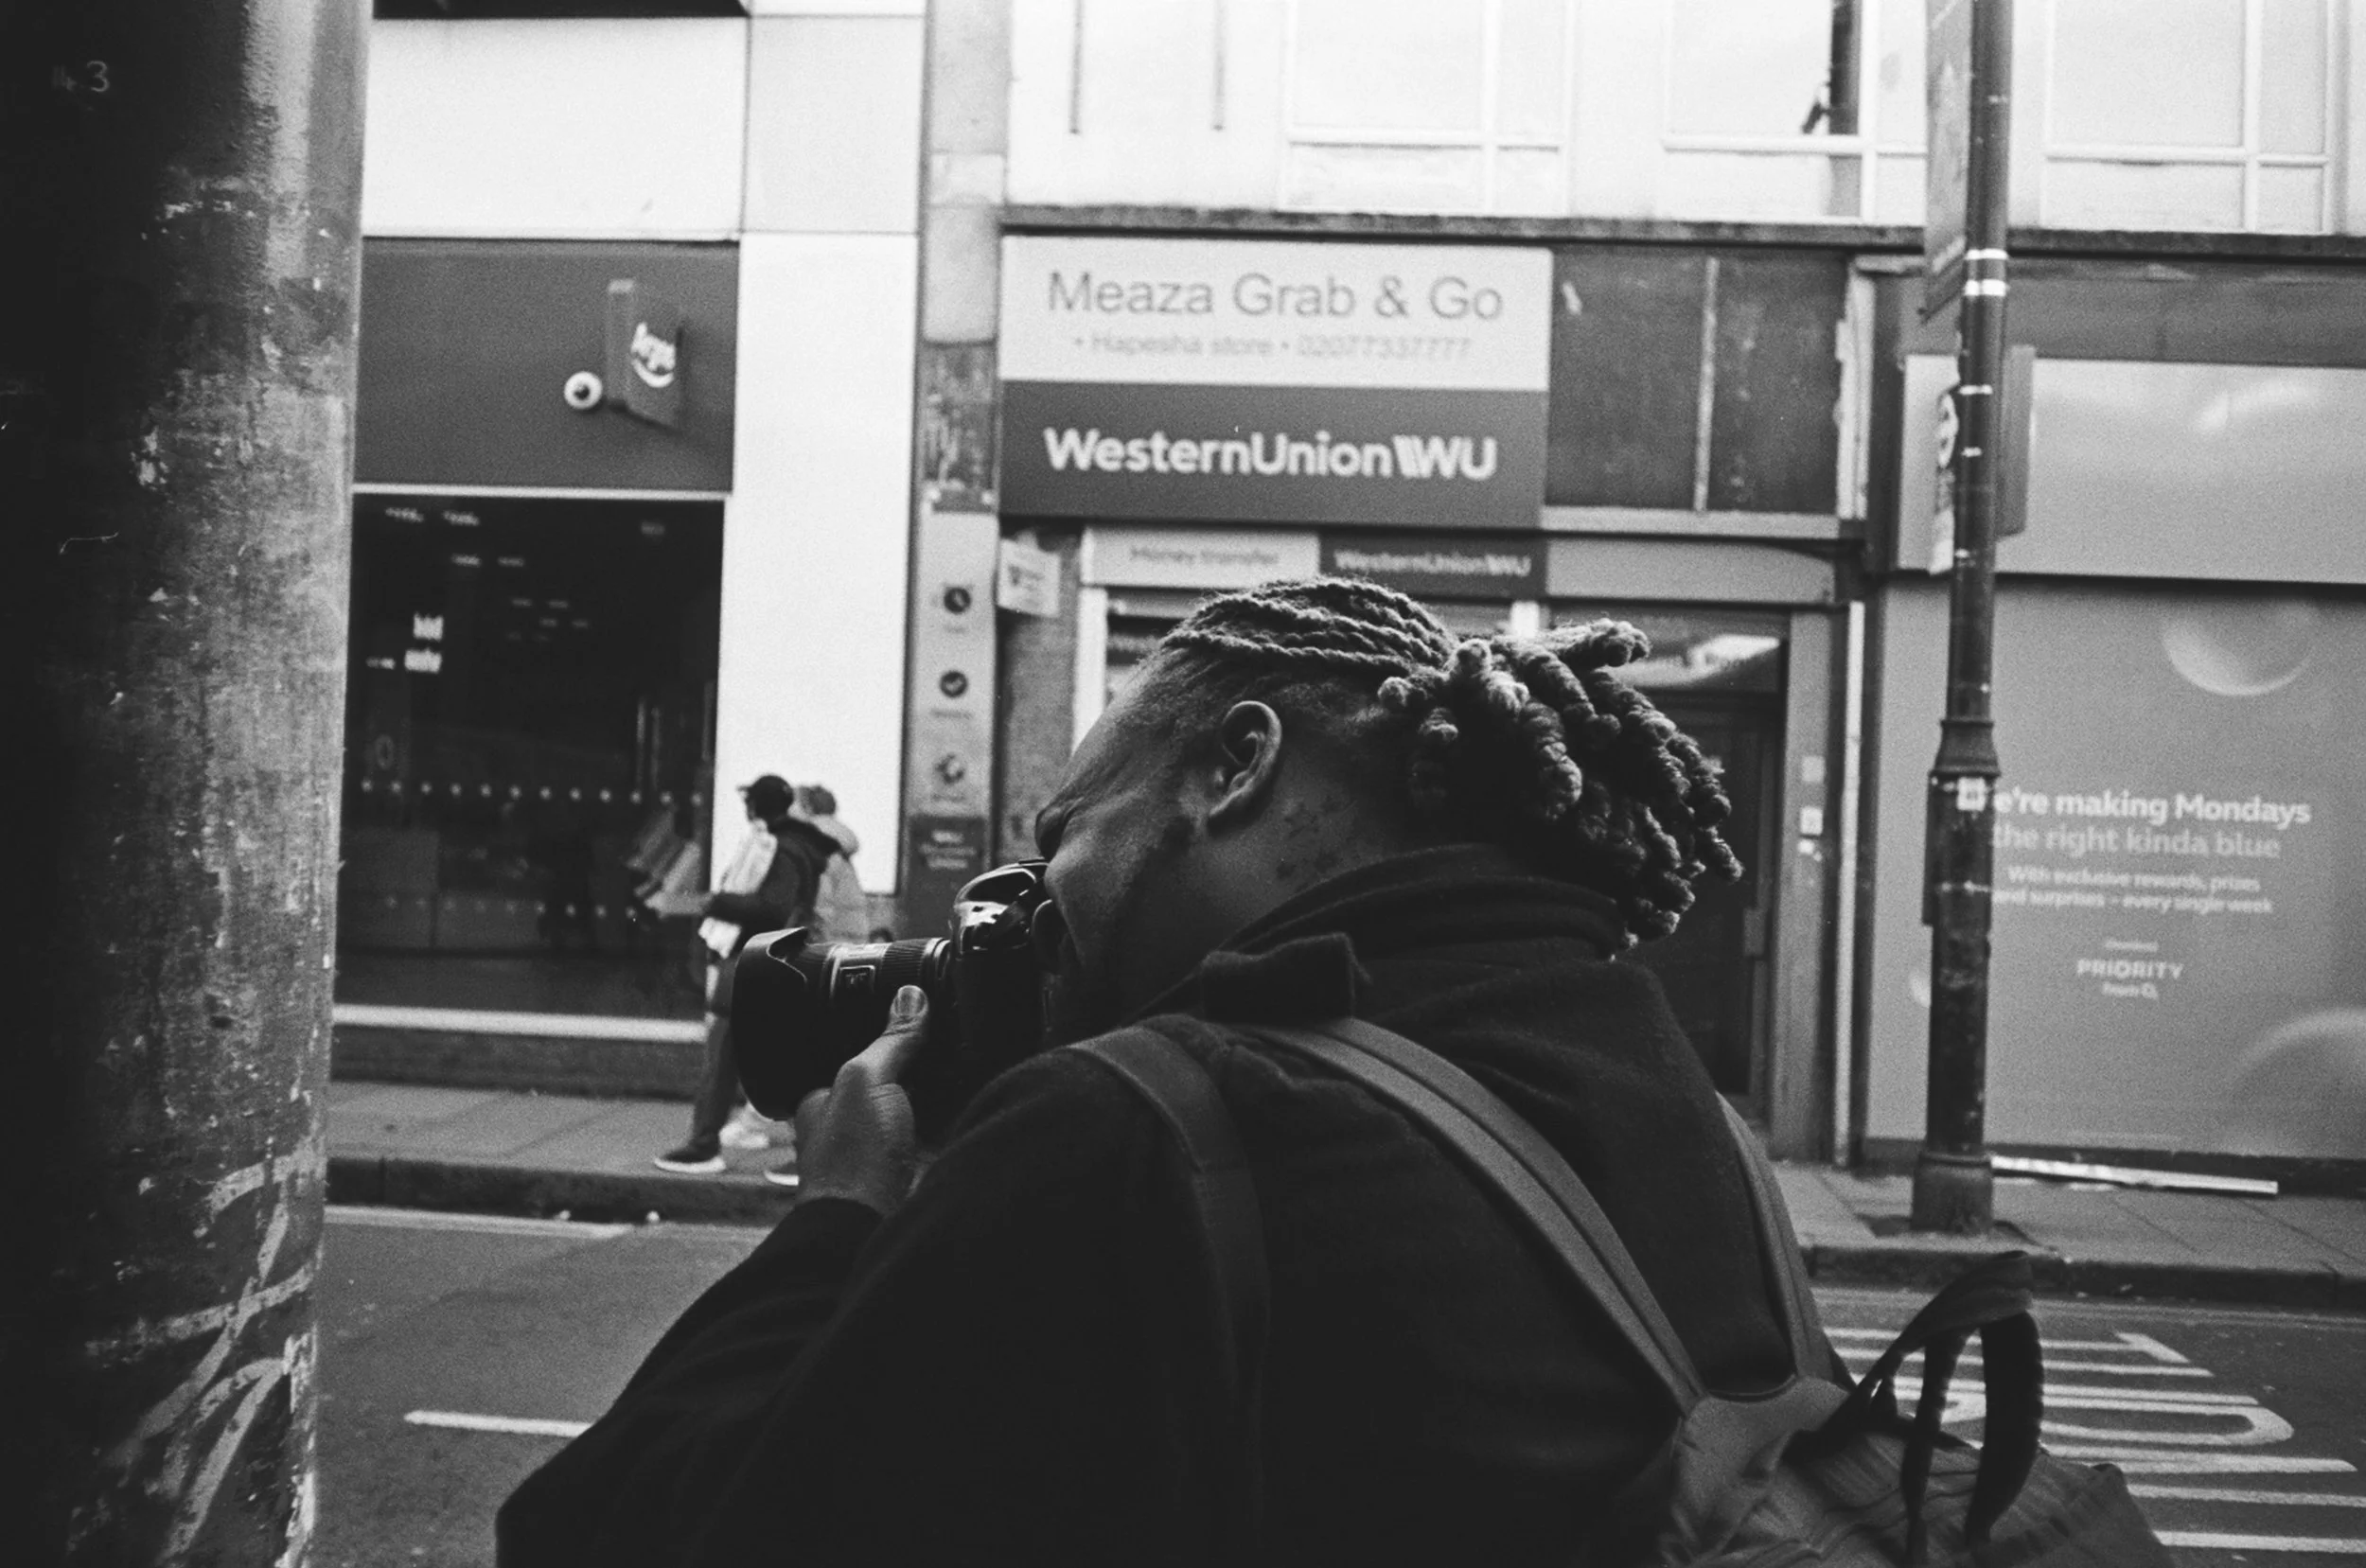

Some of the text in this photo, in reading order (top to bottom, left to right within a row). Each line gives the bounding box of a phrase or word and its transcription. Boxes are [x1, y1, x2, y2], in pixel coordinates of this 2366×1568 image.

[1047, 271, 1504, 320] Meaza Grab & Go
[1043, 427, 1393, 477] WesternUnion
[1993, 786, 2312, 831] e're making Mondays
[1993, 822, 2282, 859] the right kinda blue
[2077, 958, 2183, 978] PRIORITY
